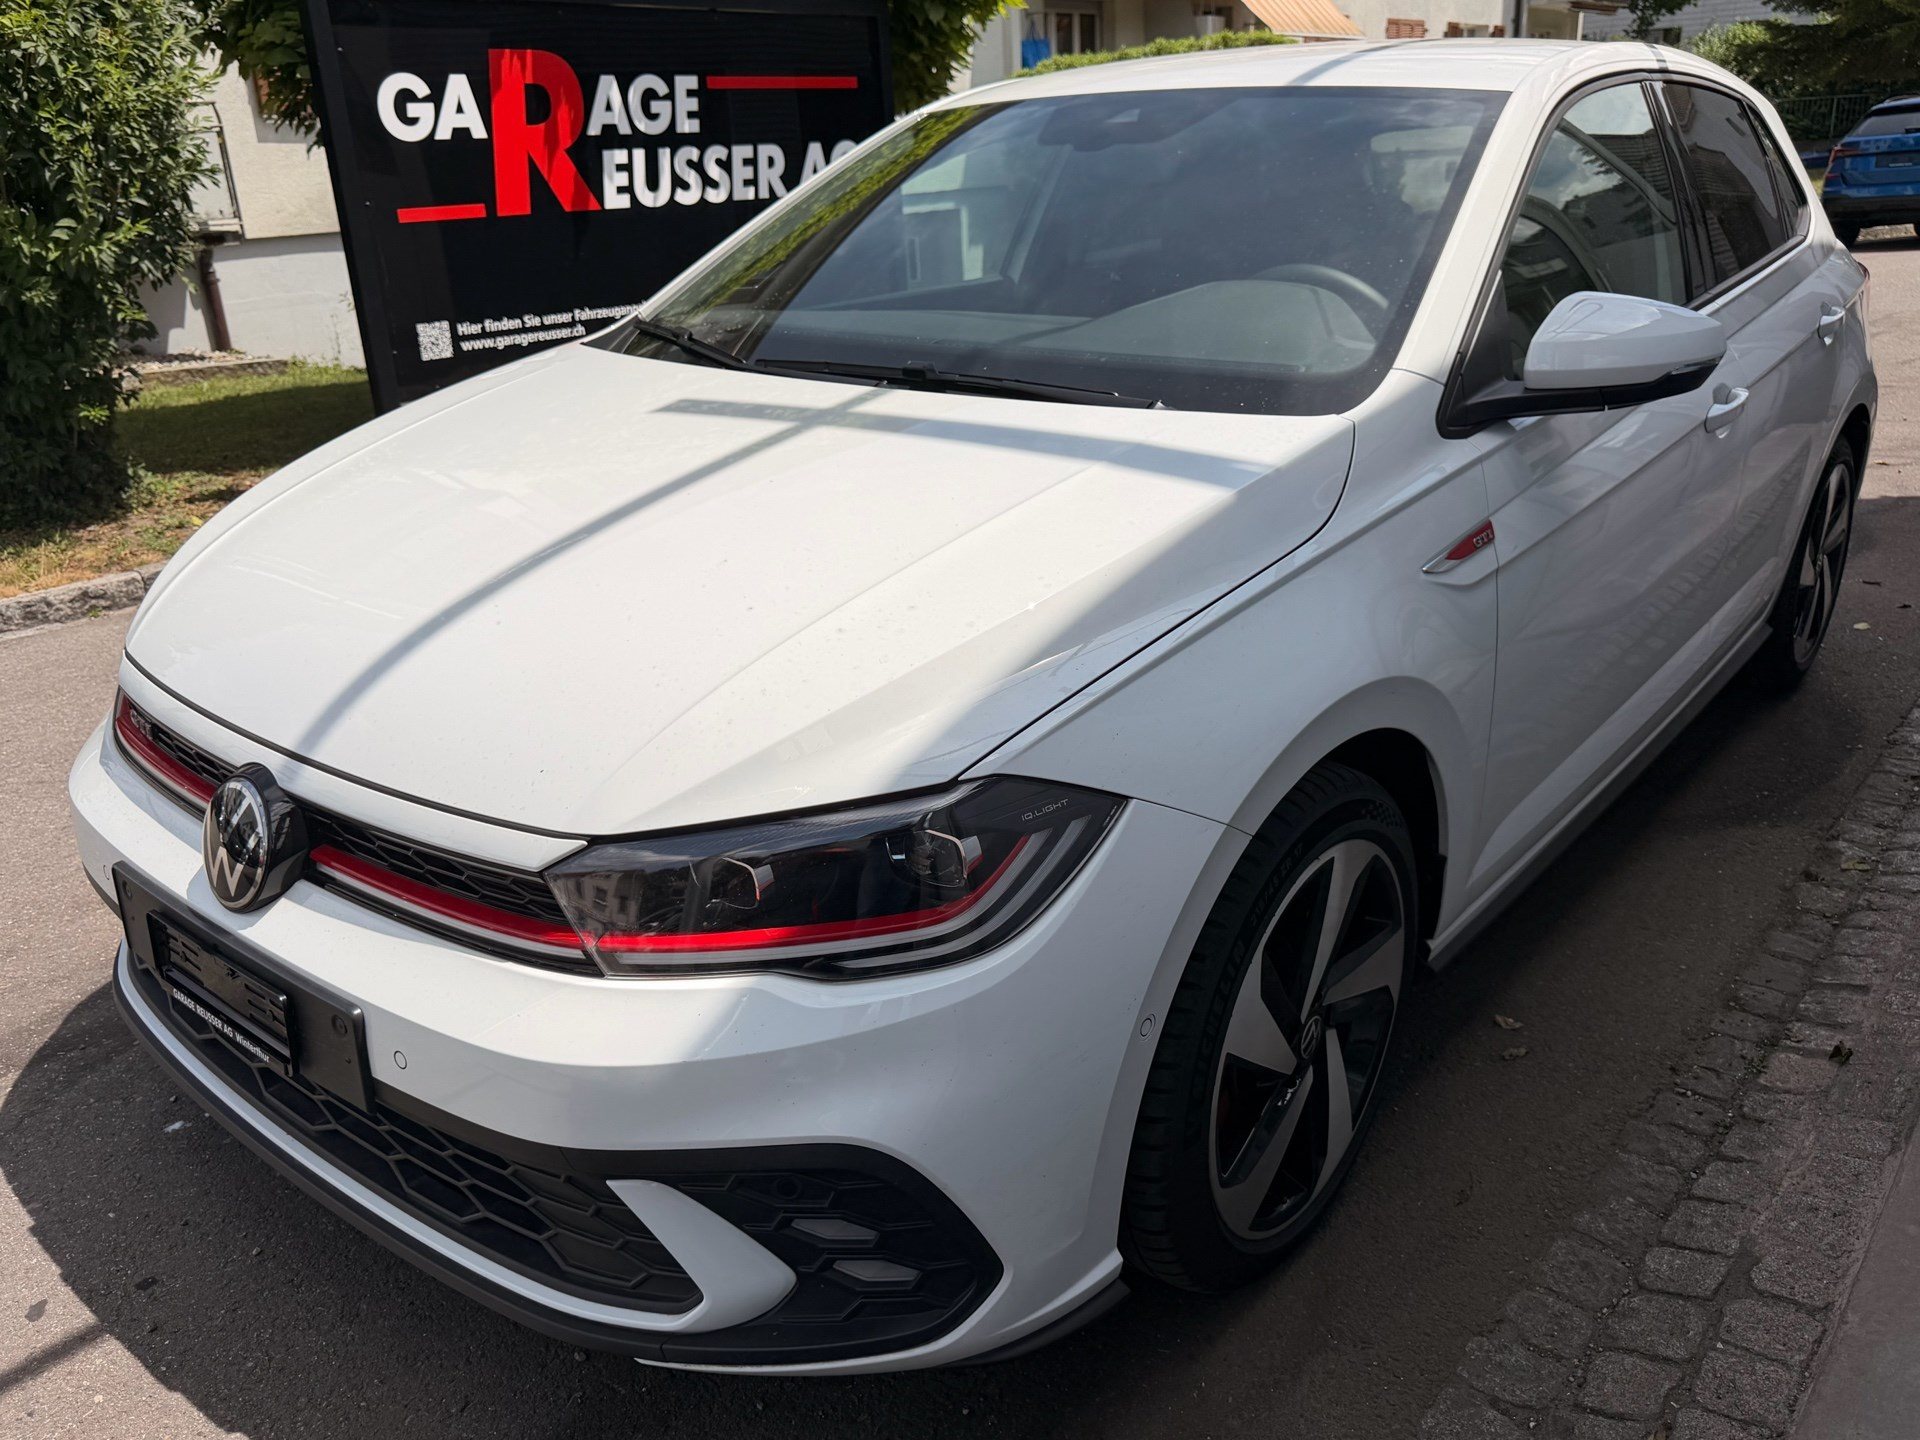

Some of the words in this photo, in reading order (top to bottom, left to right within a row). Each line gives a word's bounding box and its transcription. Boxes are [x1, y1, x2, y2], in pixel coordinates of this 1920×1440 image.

[377, 49, 700, 217] GARAGE
[456, 321, 482, 336] Hier
[483, 317, 523, 333] finden
[523, 314, 542, 328] Sie
[542, 311, 573, 326] unser
[460, 322, 586, 351] www.garagereusser.ch
[1021, 798, 1069, 822] IQ.LIGHT
[172, 988, 196, 1012] GARAGE
[196, 1004, 223, 1031] REUSSER
[223, 1024, 234, 1038] AG
[235, 1032, 270, 1063] Winterthur
